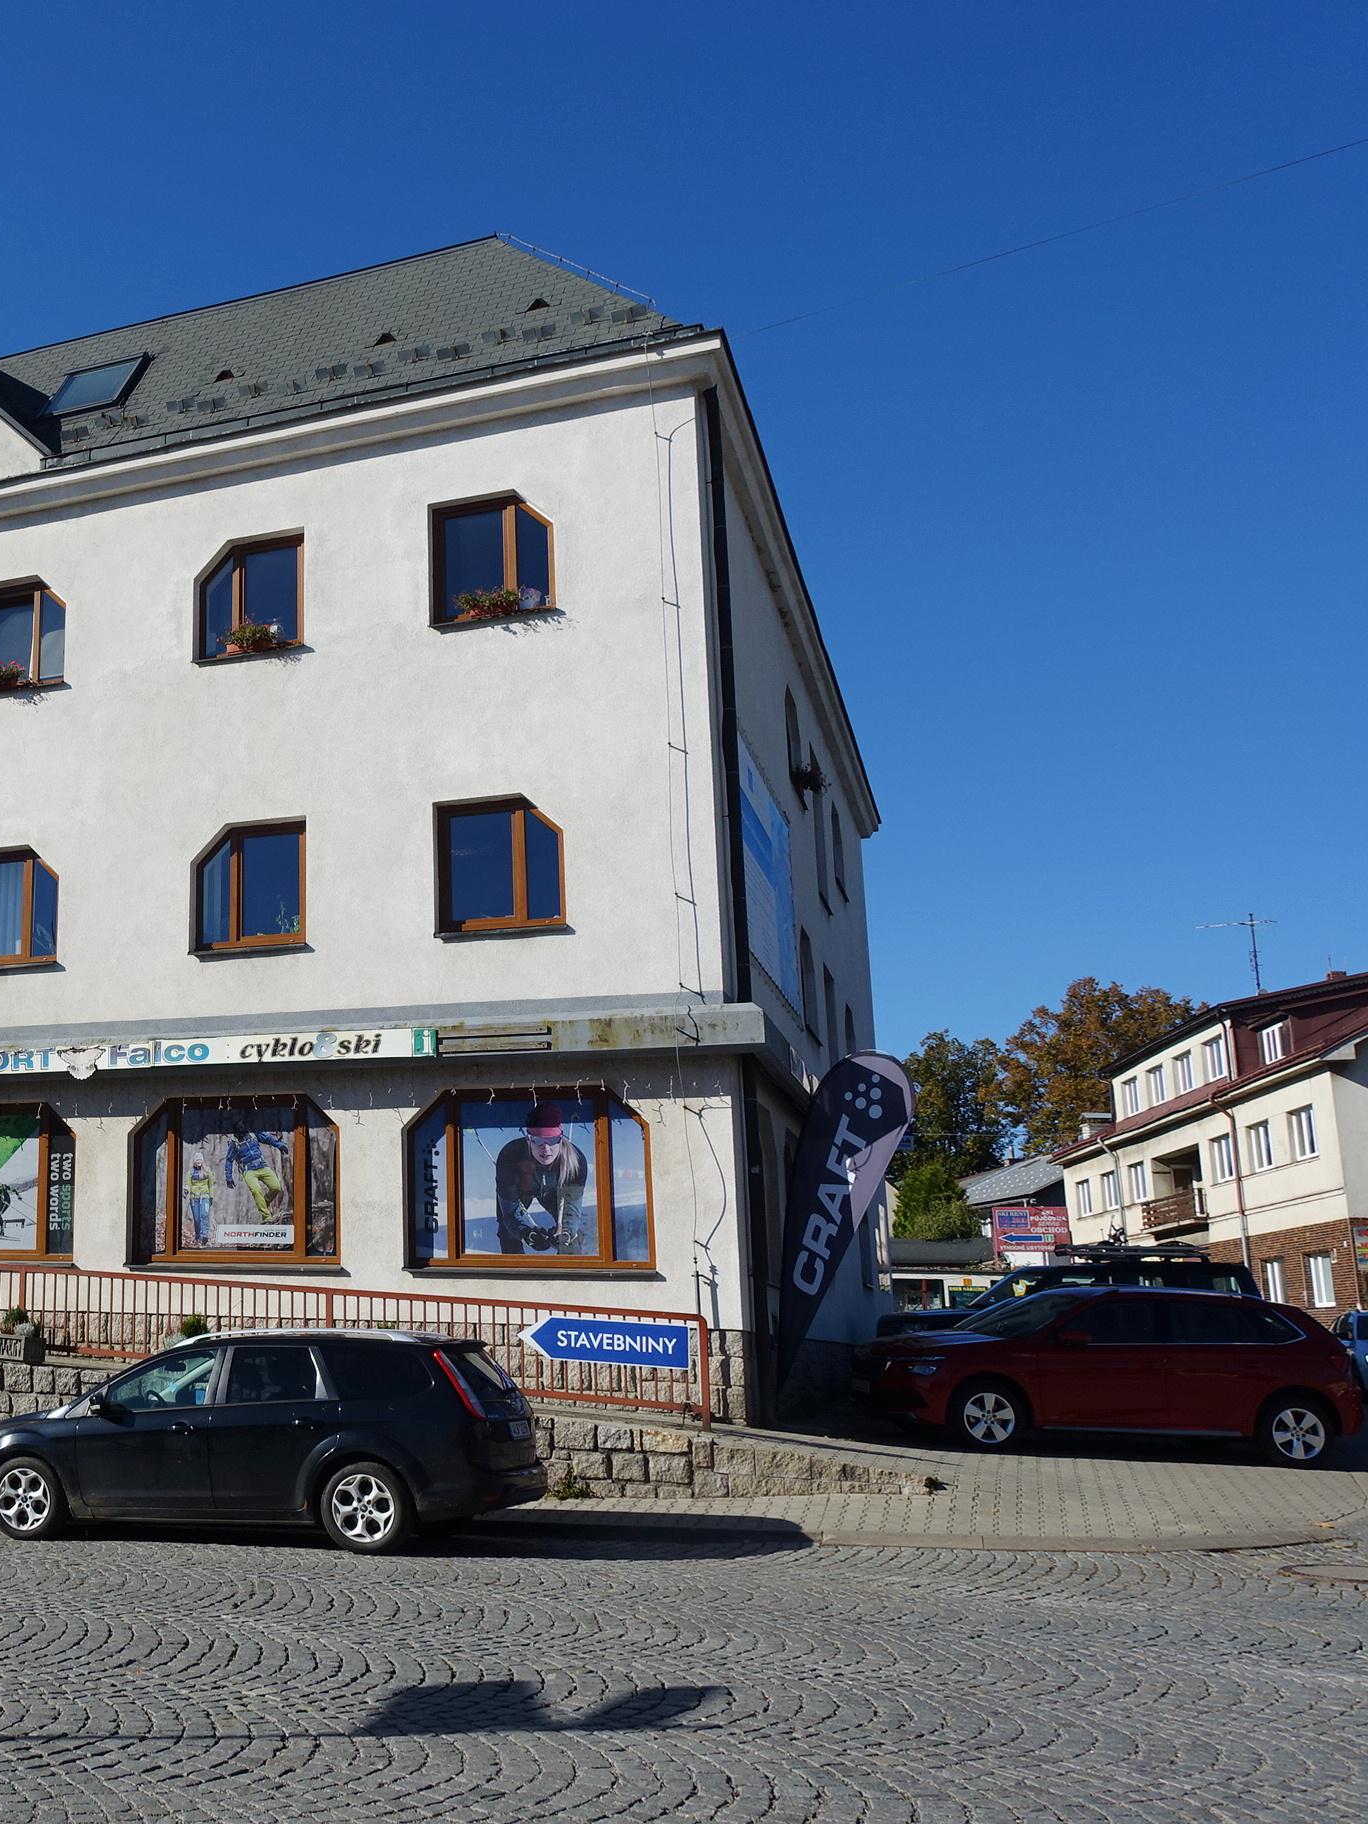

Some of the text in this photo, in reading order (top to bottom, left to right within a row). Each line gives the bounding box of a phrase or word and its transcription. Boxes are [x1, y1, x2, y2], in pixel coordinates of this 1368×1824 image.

[108, 1041, 210, 1067] Falco
[49, 1152, 62, 1231] two words
[61, 1152, 74, 1231] two sports
[424, 1158, 439, 1234] CRAFT
[792, 1112, 868, 1296] CRAFT
[1030, 1226, 1068, 1234] OBCHOD
[557, 1330, 677, 1355] STAVEBNINY
